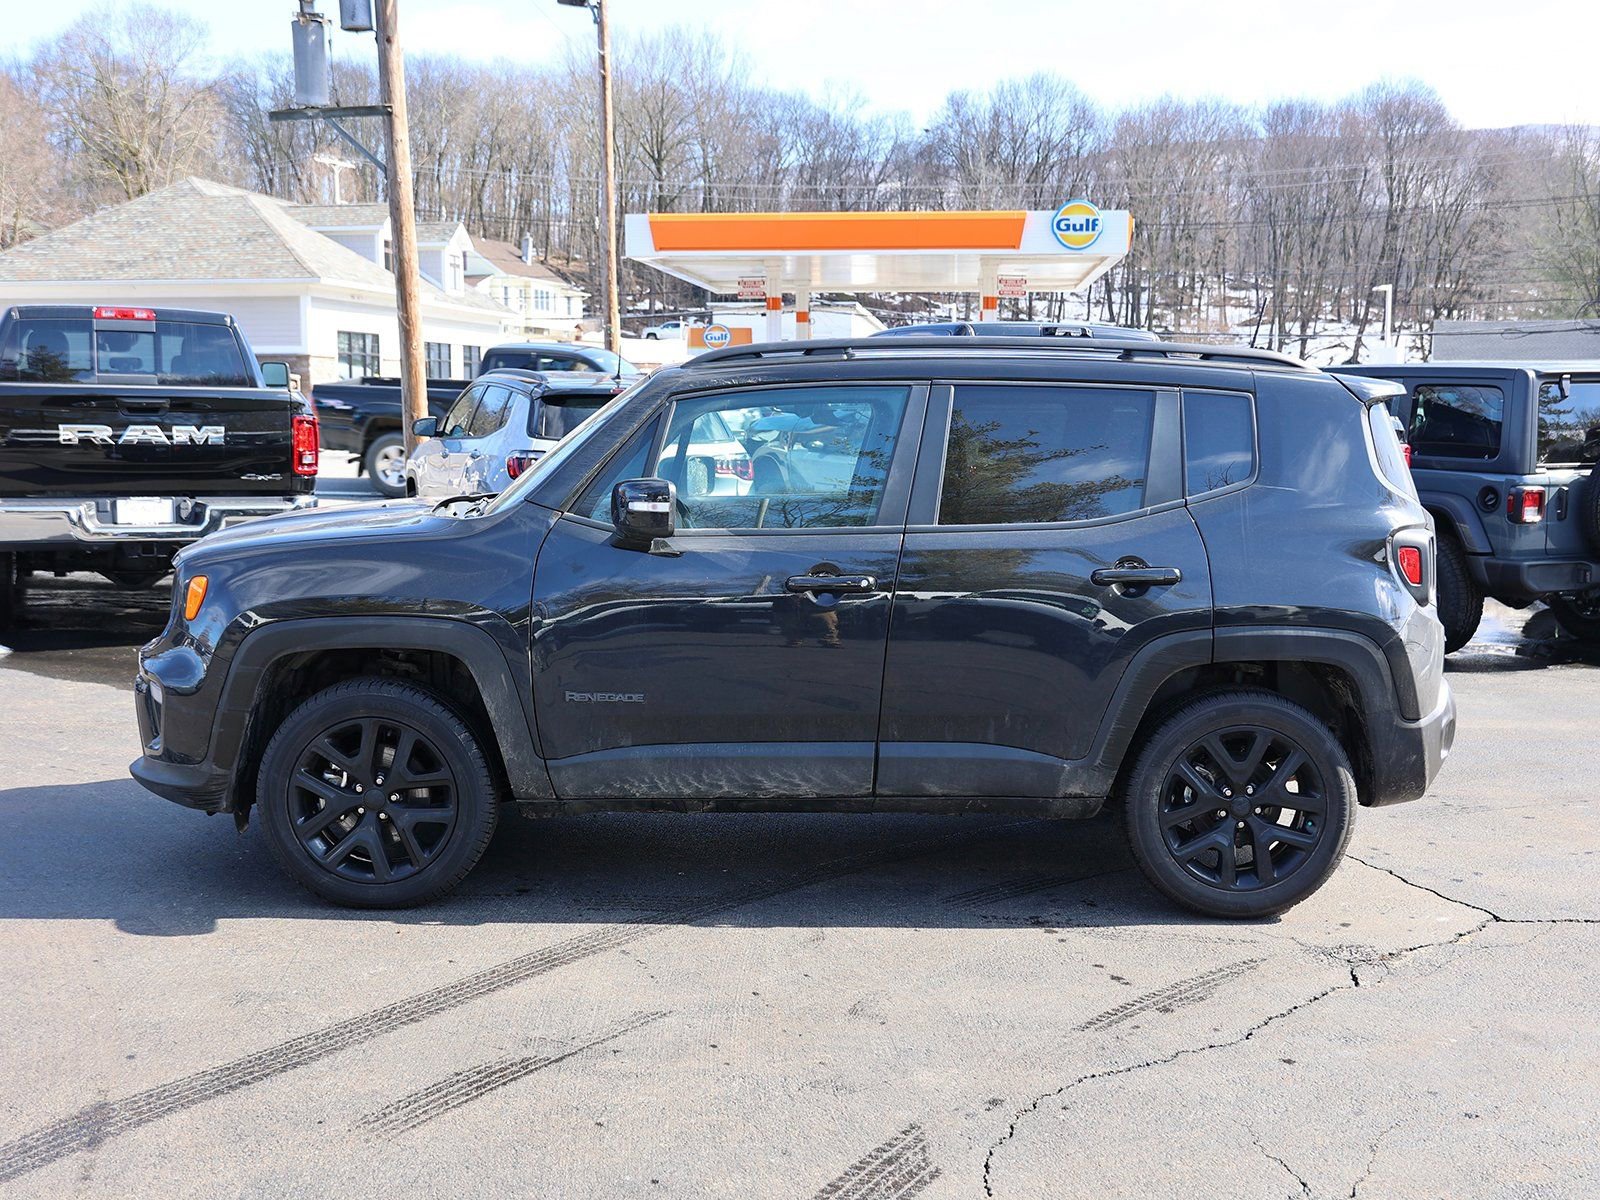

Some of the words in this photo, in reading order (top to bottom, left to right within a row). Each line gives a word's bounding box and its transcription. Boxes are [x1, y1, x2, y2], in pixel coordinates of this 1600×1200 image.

[1056, 218, 1099, 232] Gulf
[705, 333, 728, 341] Gulf
[58, 424, 225, 445] RAM
